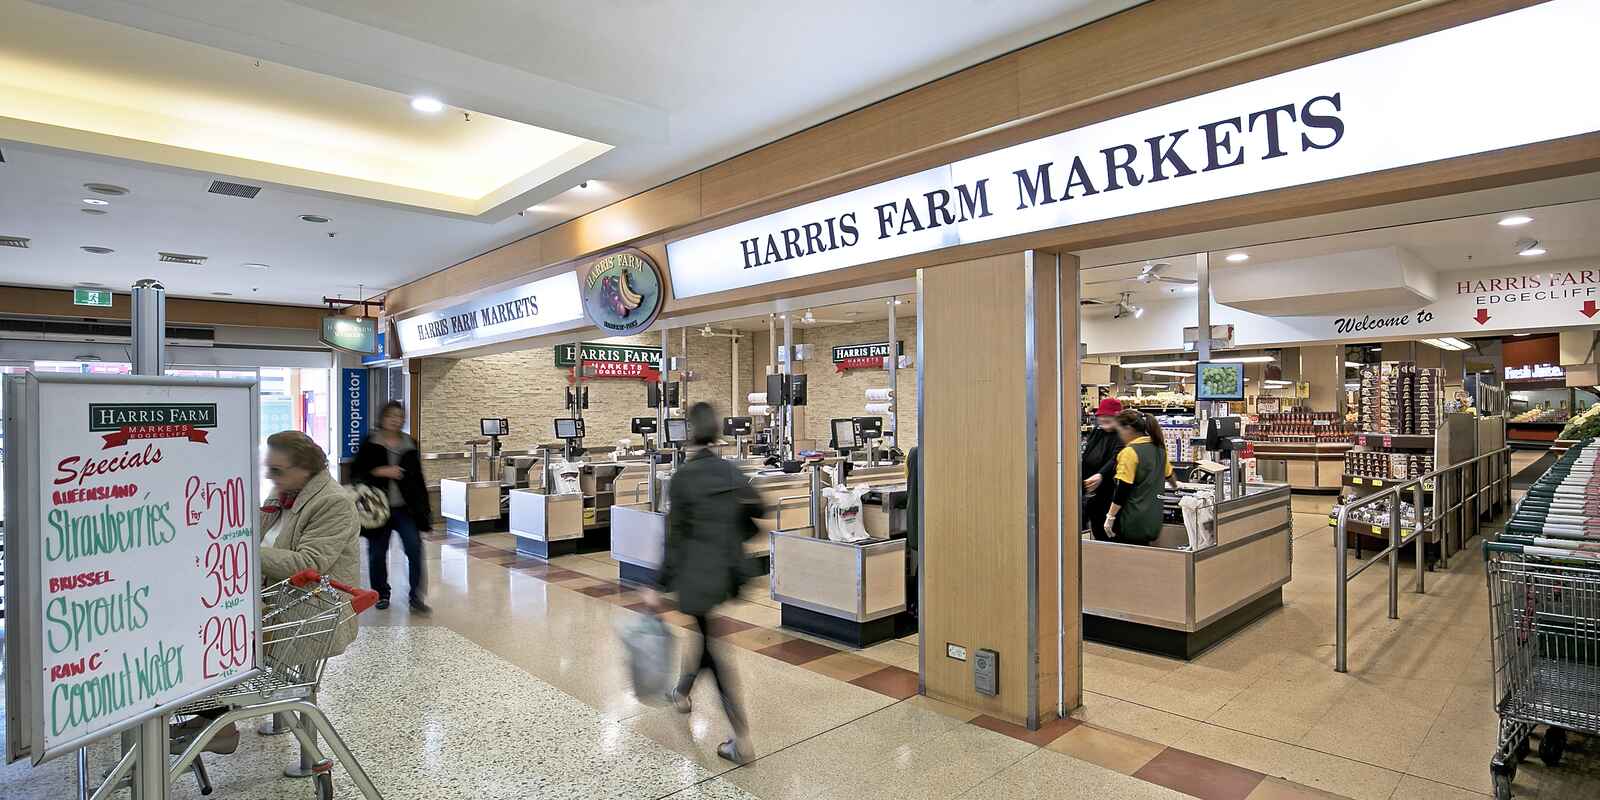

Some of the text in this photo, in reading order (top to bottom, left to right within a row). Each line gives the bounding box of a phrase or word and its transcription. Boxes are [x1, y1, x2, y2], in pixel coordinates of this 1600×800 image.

[740, 92, 1345, 269] HARRIS FARM MARKETS
[587, 254, 644, 289] HARRIS FARM
[1456, 269, 1600, 294] HARRIS FAR
[1476, 287, 1597, 305] EDGECLIFF
[417, 295, 539, 341] HARRIS FARM MARKETS
[1334, 309, 1434, 334] Welcome to
[567, 347, 661, 363] HARRIS FARM
[836, 348, 868, 359] HARRIS
[100, 408, 209, 424] HARRIS FARM
[348, 372, 363, 454] chiropractor
[129, 425, 189, 433] MARKETS
[54, 443, 163, 486] Specials
[53, 484, 138, 506] QUEENSLAND
[46, 490, 176, 562] Strawberries
[49, 570, 115, 594] BRUSSEL
[46, 580, 149, 654] Sprouts
[50, 652, 104, 683] RAW C
[52, 640, 184, 736] Coconut Water
